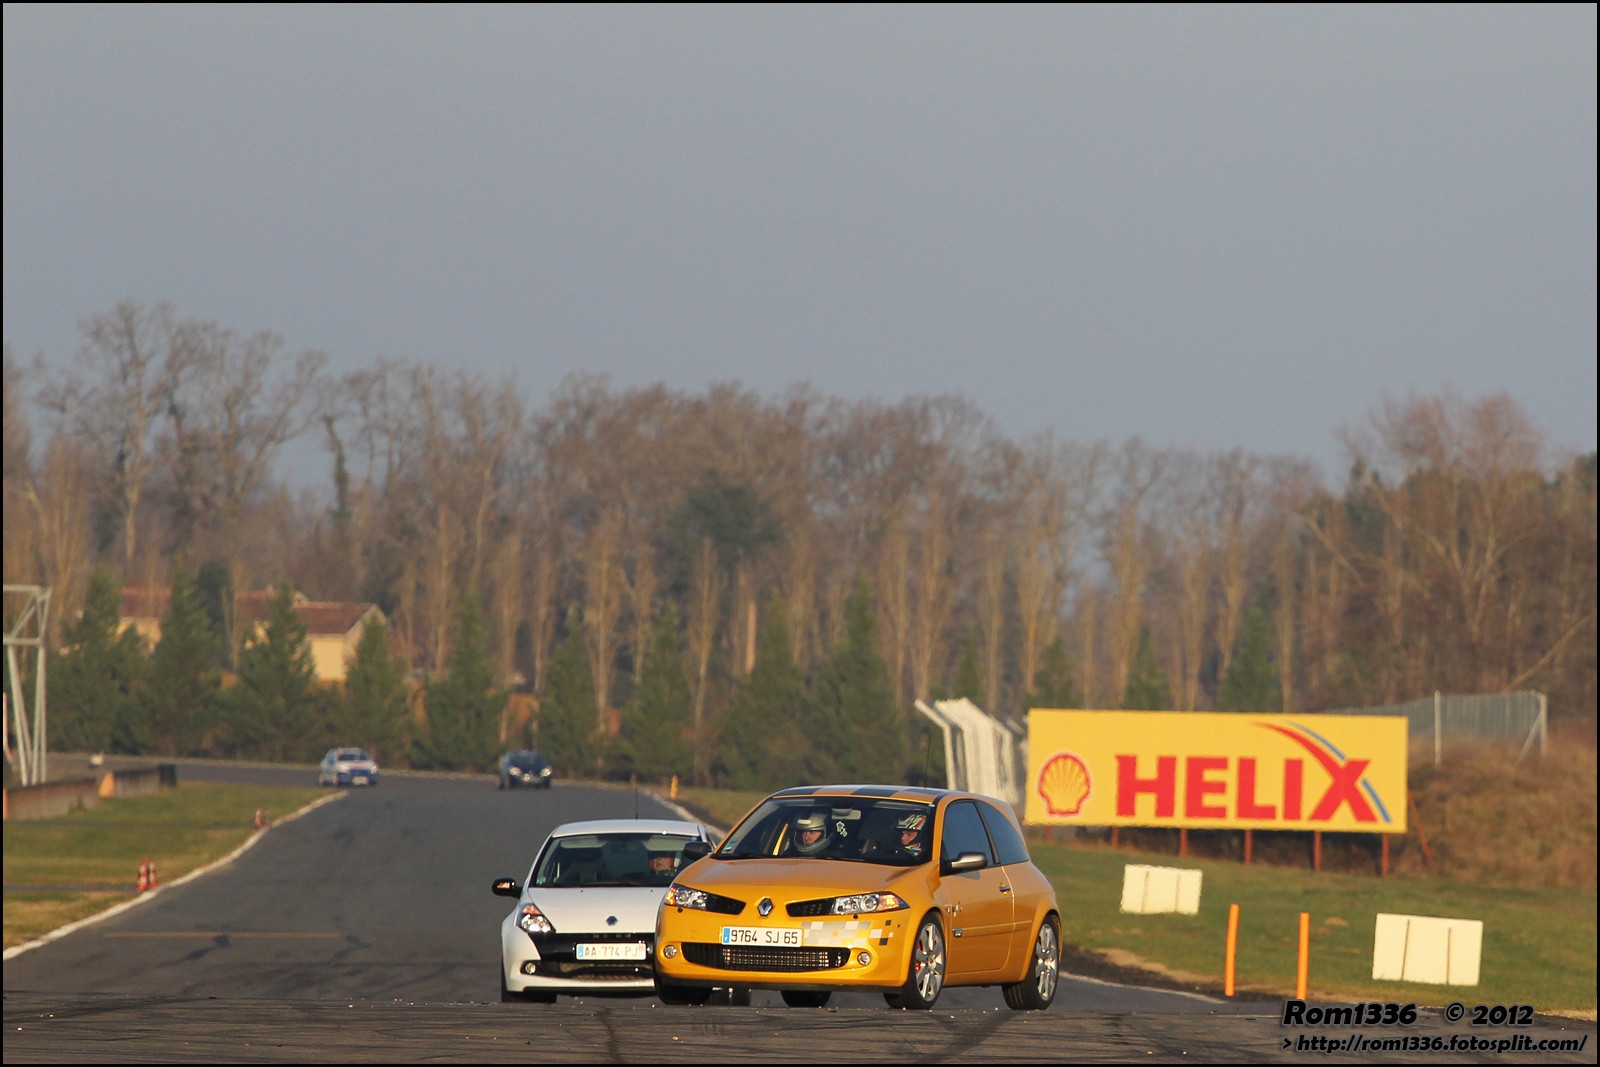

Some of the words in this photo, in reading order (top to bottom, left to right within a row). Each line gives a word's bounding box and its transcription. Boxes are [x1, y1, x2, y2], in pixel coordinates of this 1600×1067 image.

[1115, 754, 1378, 823] HELIX
[731, 929, 757, 943] 9764
[765, 930, 780, 944] SJ
[783, 931, 798, 945] 65
